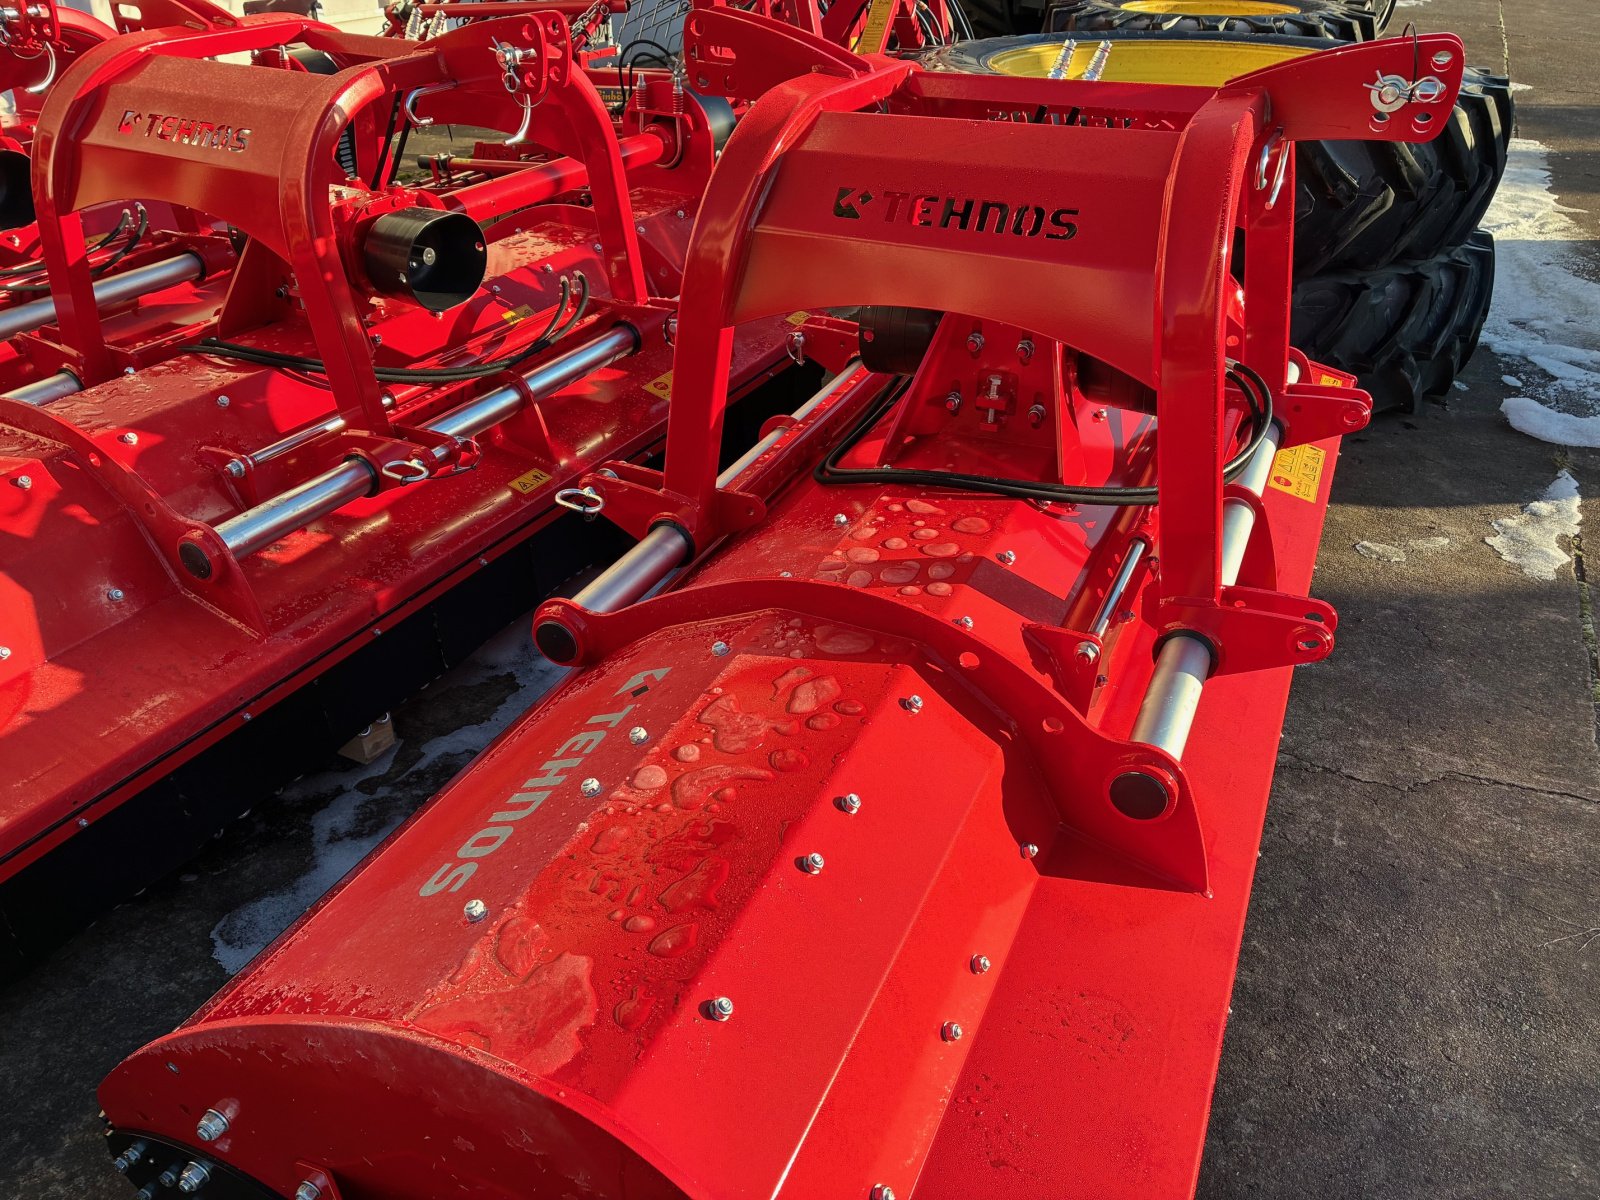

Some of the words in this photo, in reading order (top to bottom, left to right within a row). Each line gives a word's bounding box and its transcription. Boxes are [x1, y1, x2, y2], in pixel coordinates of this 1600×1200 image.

[144, 113, 251, 152] TEHNOS
[882, 190, 1080, 240] TEHNOS
[419, 703, 636, 897] TEHNOS
